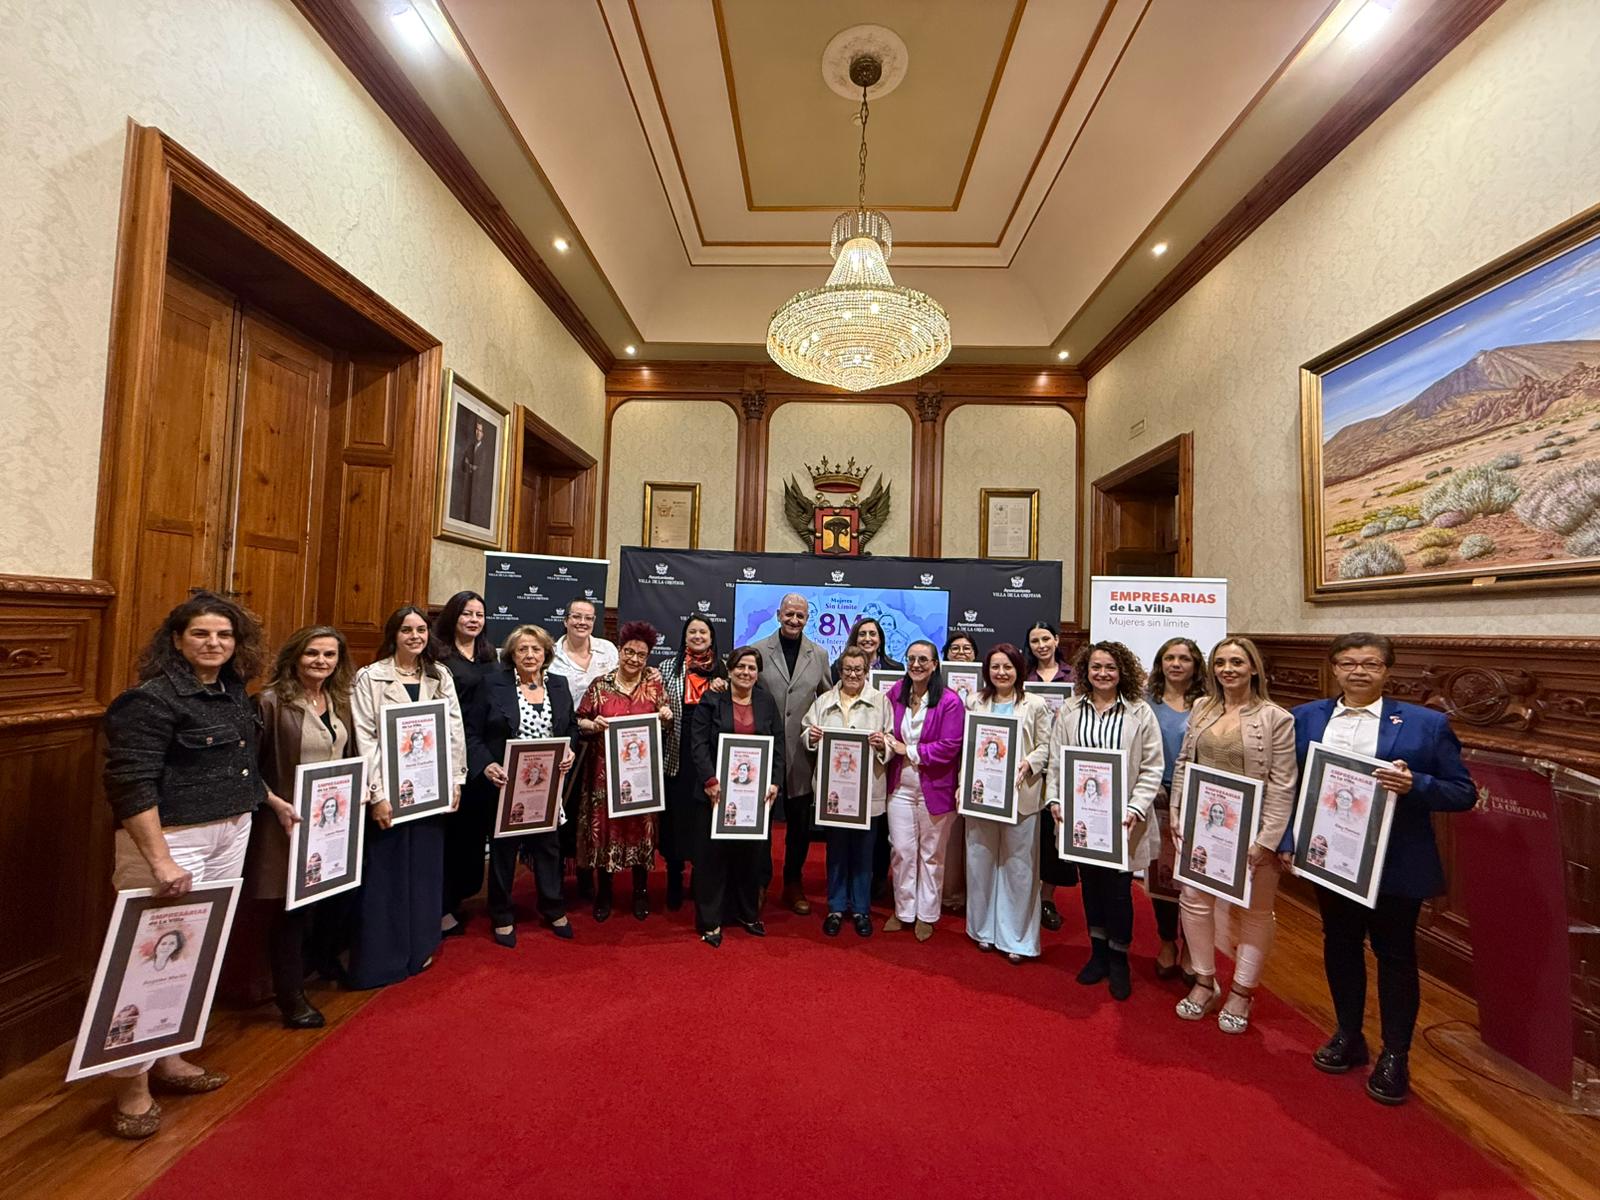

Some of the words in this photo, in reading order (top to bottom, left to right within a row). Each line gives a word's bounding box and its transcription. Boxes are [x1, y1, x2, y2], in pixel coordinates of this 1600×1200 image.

[1110, 591, 1216, 603] EMPRESARIAS
[1110, 603, 1125, 612] de
[1128, 604, 1141, 612] La
[1145, 604, 1172, 613] Villa
[819, 613, 862, 636] 8M
[1109, 617, 1145, 627] Mujeres
[1148, 619, 1160, 627] sin
[1163, 619, 1190, 628] límite
